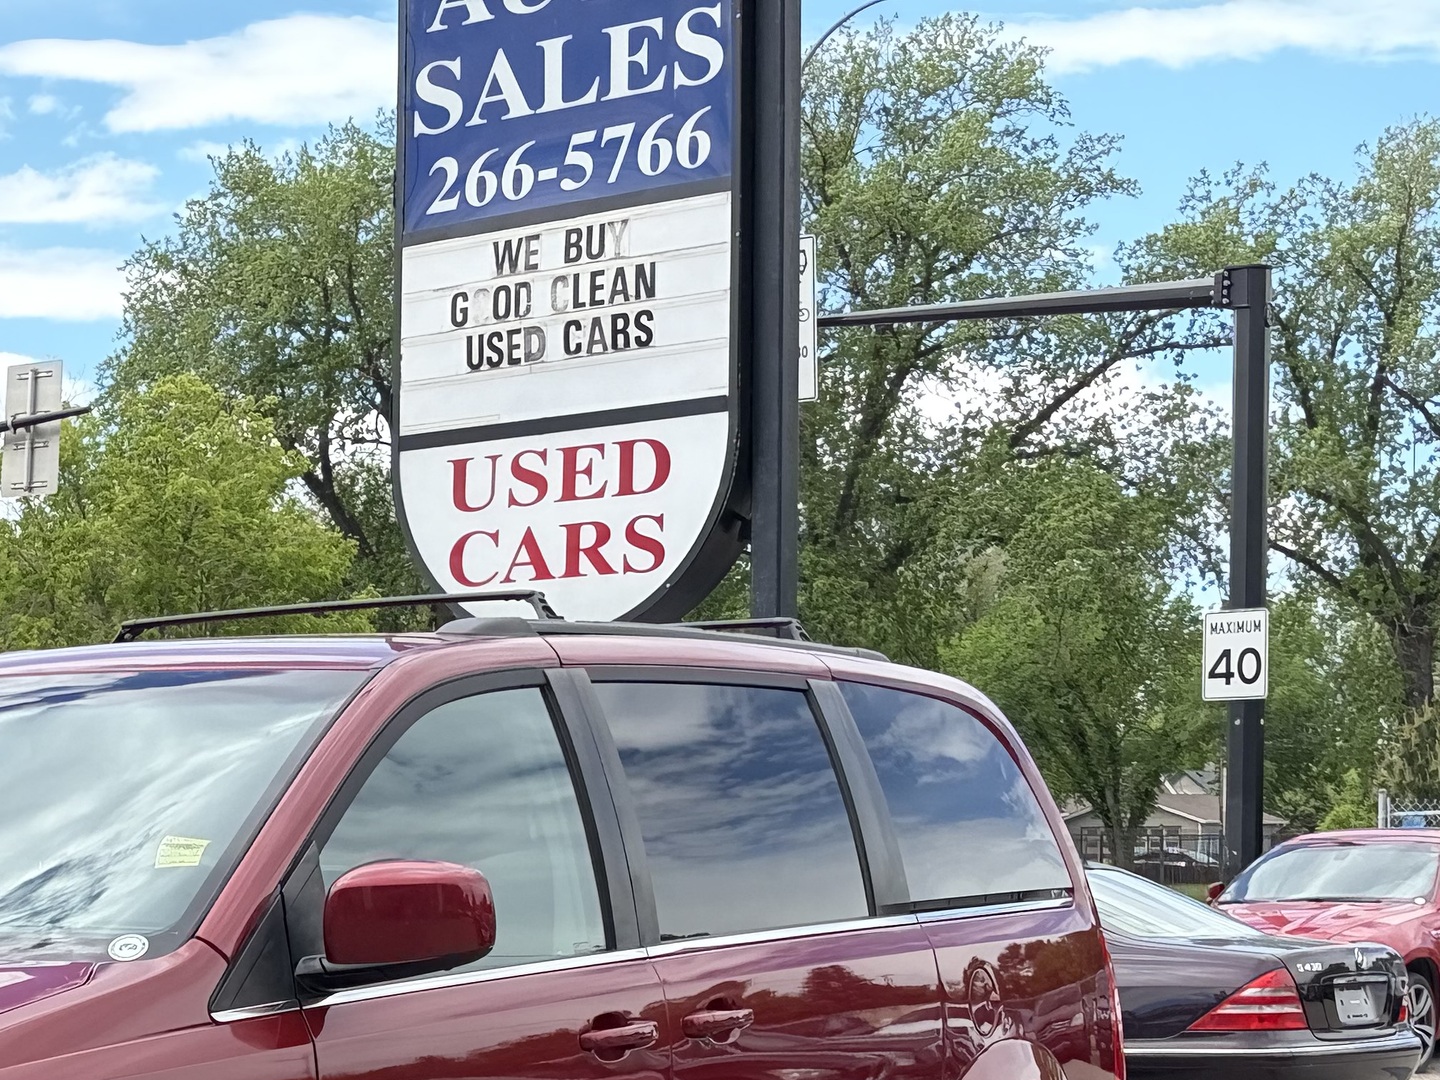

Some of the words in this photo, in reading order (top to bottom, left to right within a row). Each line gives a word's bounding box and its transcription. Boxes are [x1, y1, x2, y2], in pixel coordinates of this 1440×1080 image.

[414, 2, 724, 137] SALES
[426, 105, 712, 215] 266-5766
[493, 234, 541, 276] WE
[564, 219, 629, 263] BUY
[551, 262, 656, 312] CLEAN
[466, 325, 546, 370] USED
[564, 309, 654, 355] CARS
[447, 438, 671, 512] USED
[449, 513, 665, 587] CARS
[1210, 620, 1262, 635] MAXIMUM
[1208, 647, 1262, 685] 40
